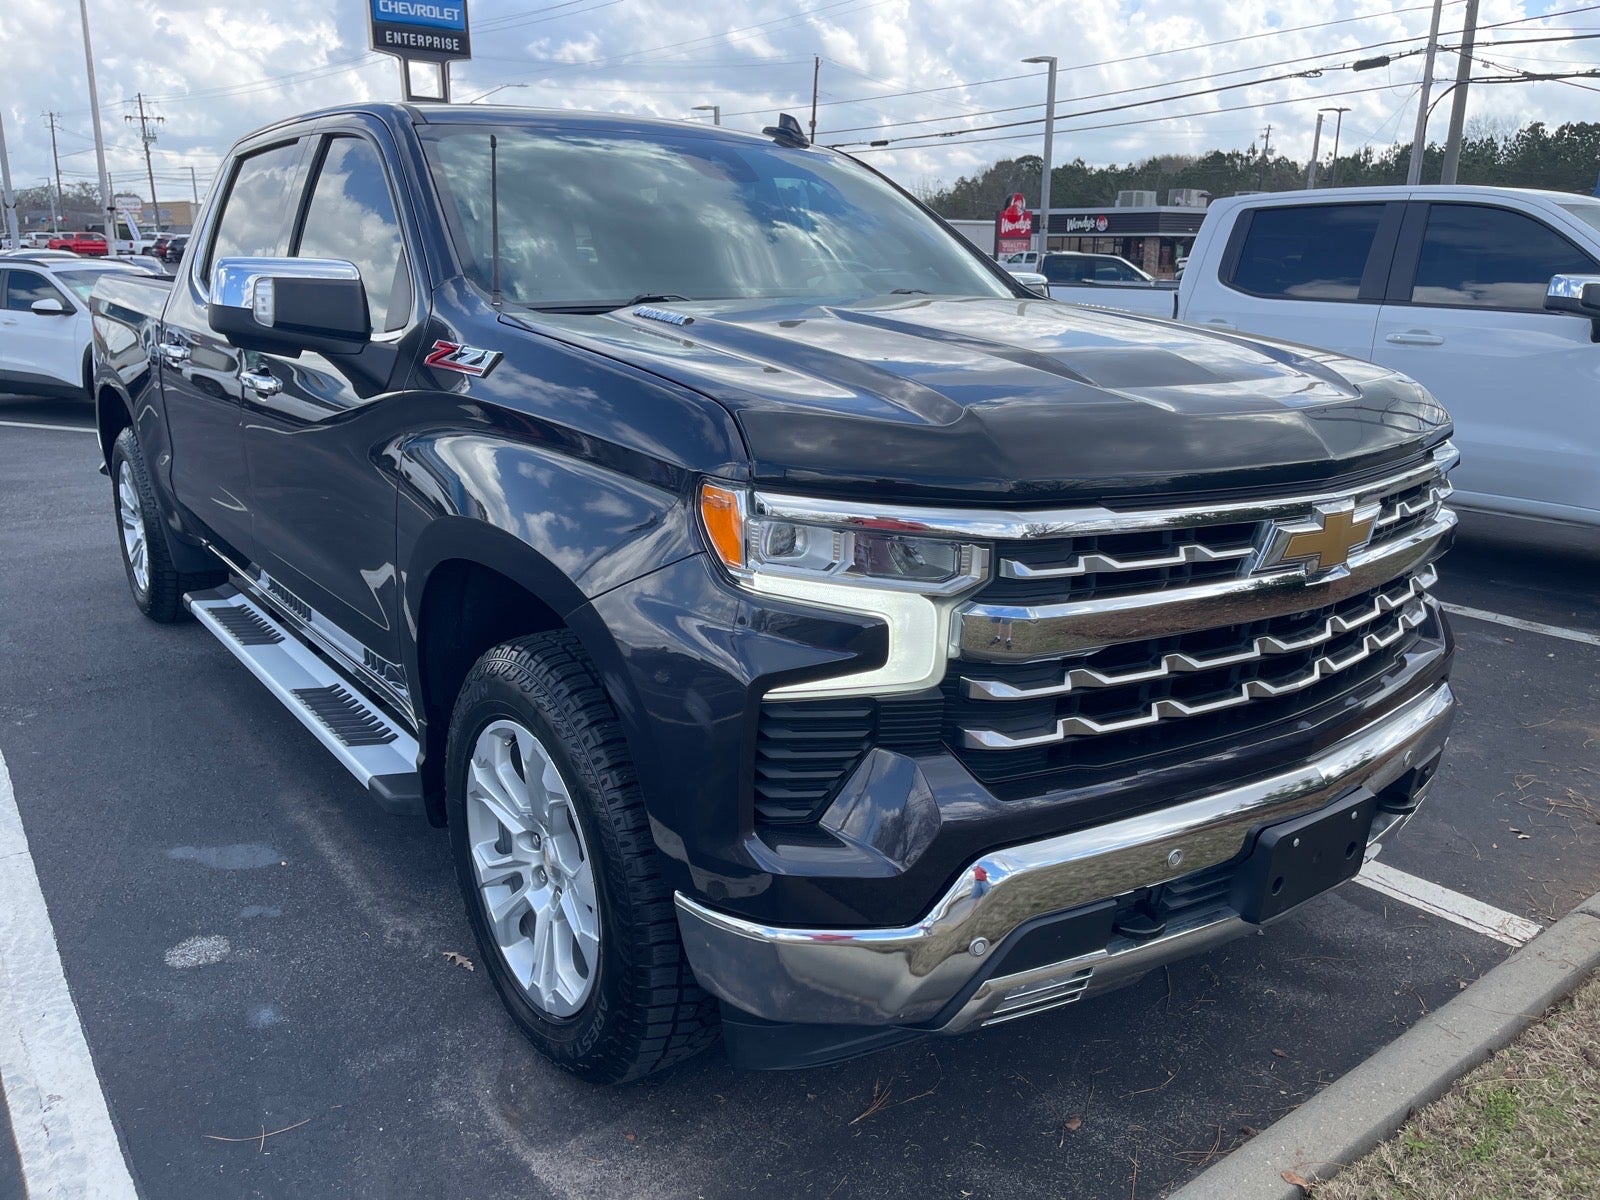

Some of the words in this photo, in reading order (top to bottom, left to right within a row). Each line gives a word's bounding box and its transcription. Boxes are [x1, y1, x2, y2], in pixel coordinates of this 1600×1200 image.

[379, 0, 461, 21] CHEVROLET
[385, 31, 460, 51] ENTERPRISE
[1001, 215, 1032, 234] Wendy's
[1066, 215, 1095, 232] Wendy's
[424, 339, 503, 378] Z71
